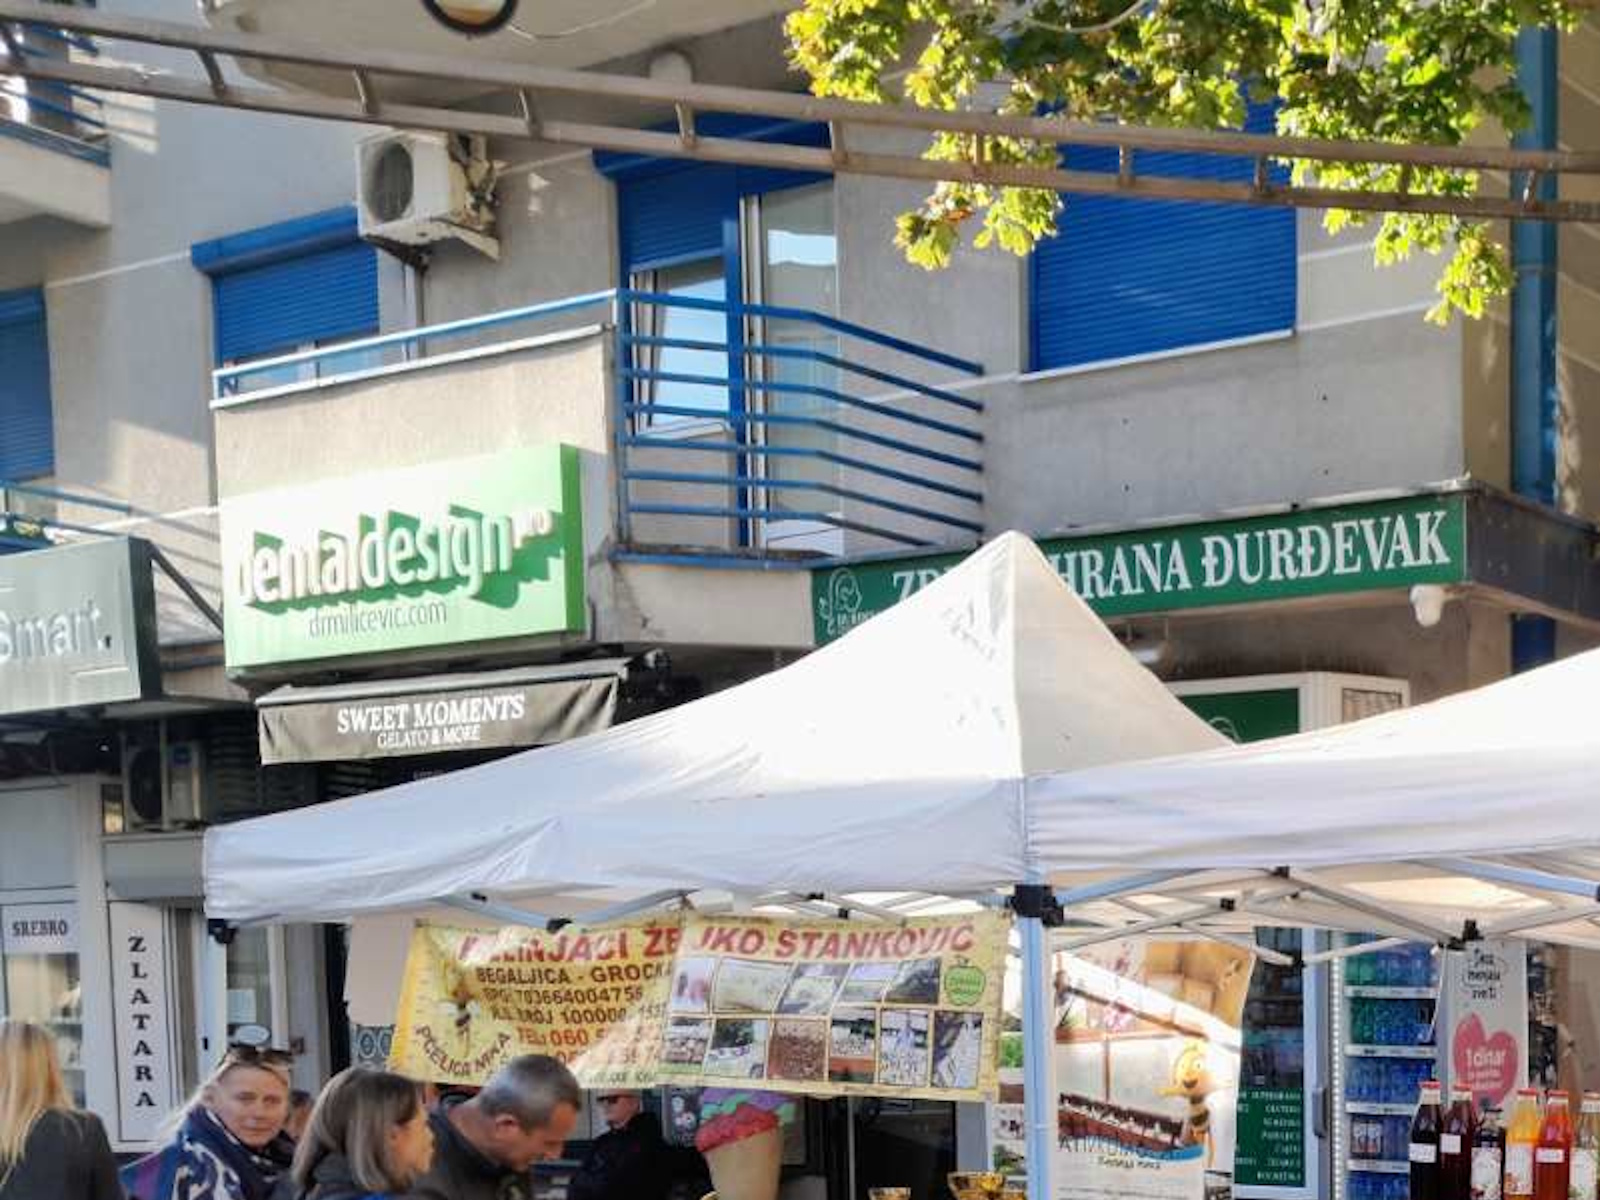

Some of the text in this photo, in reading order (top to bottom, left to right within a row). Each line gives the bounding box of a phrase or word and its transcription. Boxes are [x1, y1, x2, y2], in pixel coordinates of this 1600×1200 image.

[1049, 511, 1451, 598] HRANA ĐURĐEVAK
[309, 601, 448, 638] drmilicevic.com
[337, 693, 526, 734] SWEET MOMENTS
[377, 730, 430, 749] GELATO
[444, 724, 481, 743] MORE
[128, 936, 156, 1107] ZLATARA
